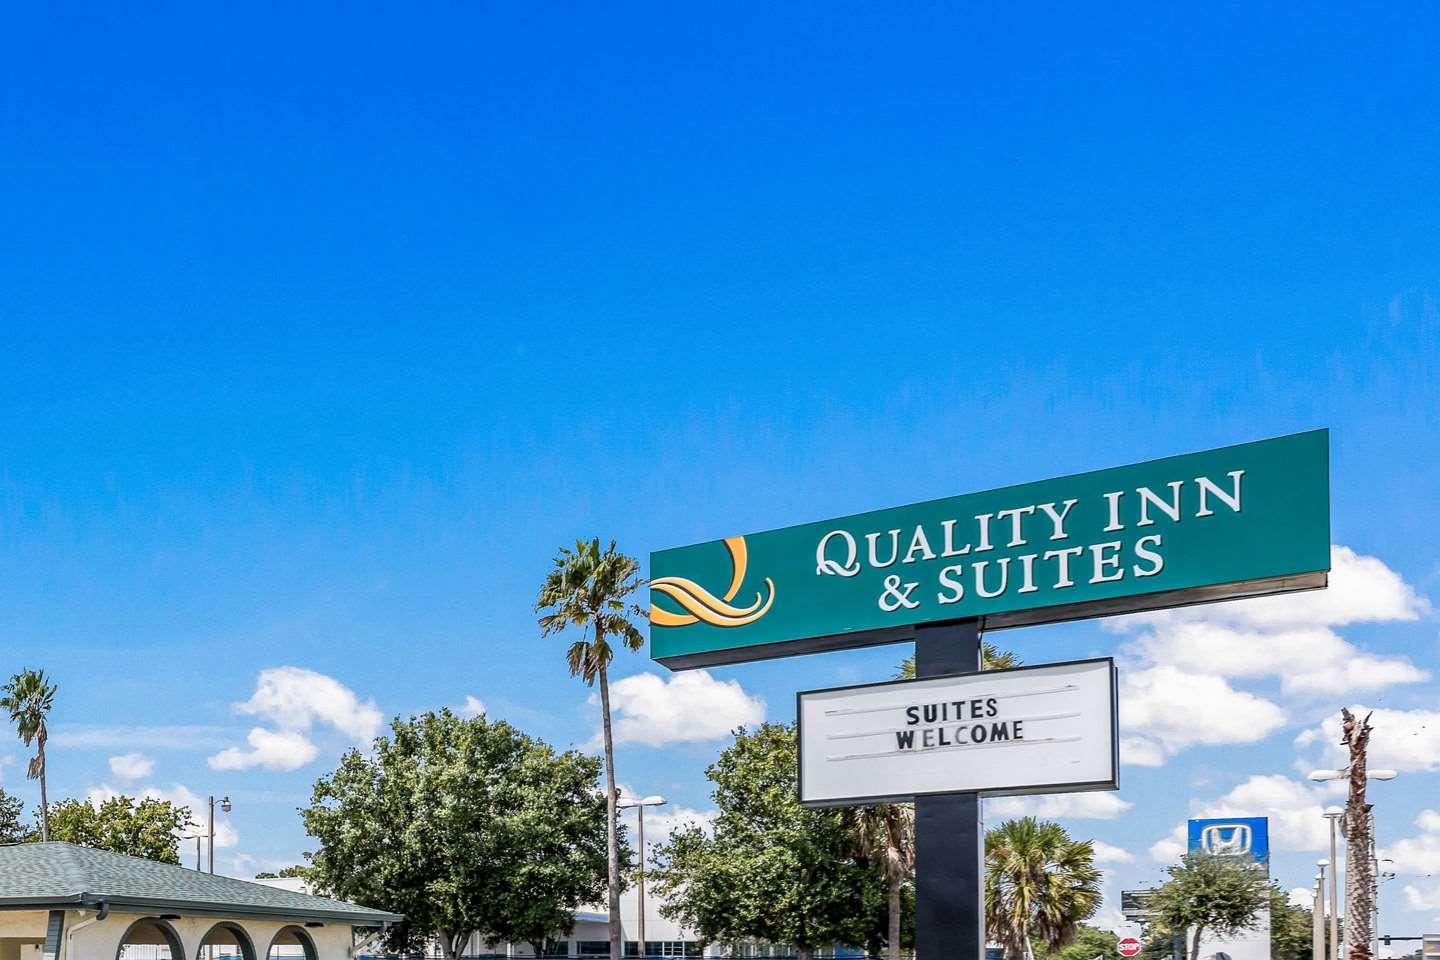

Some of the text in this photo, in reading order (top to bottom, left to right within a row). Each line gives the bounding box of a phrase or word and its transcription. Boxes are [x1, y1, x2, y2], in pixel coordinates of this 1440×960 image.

[816, 470, 1246, 578] QUALITY INN
[878, 534, 1165, 612] & SUITES
[906, 698, 998, 725] SUITES
[896, 720, 1024, 749] WELCOME
[1119, 943, 1140, 951] STOP
